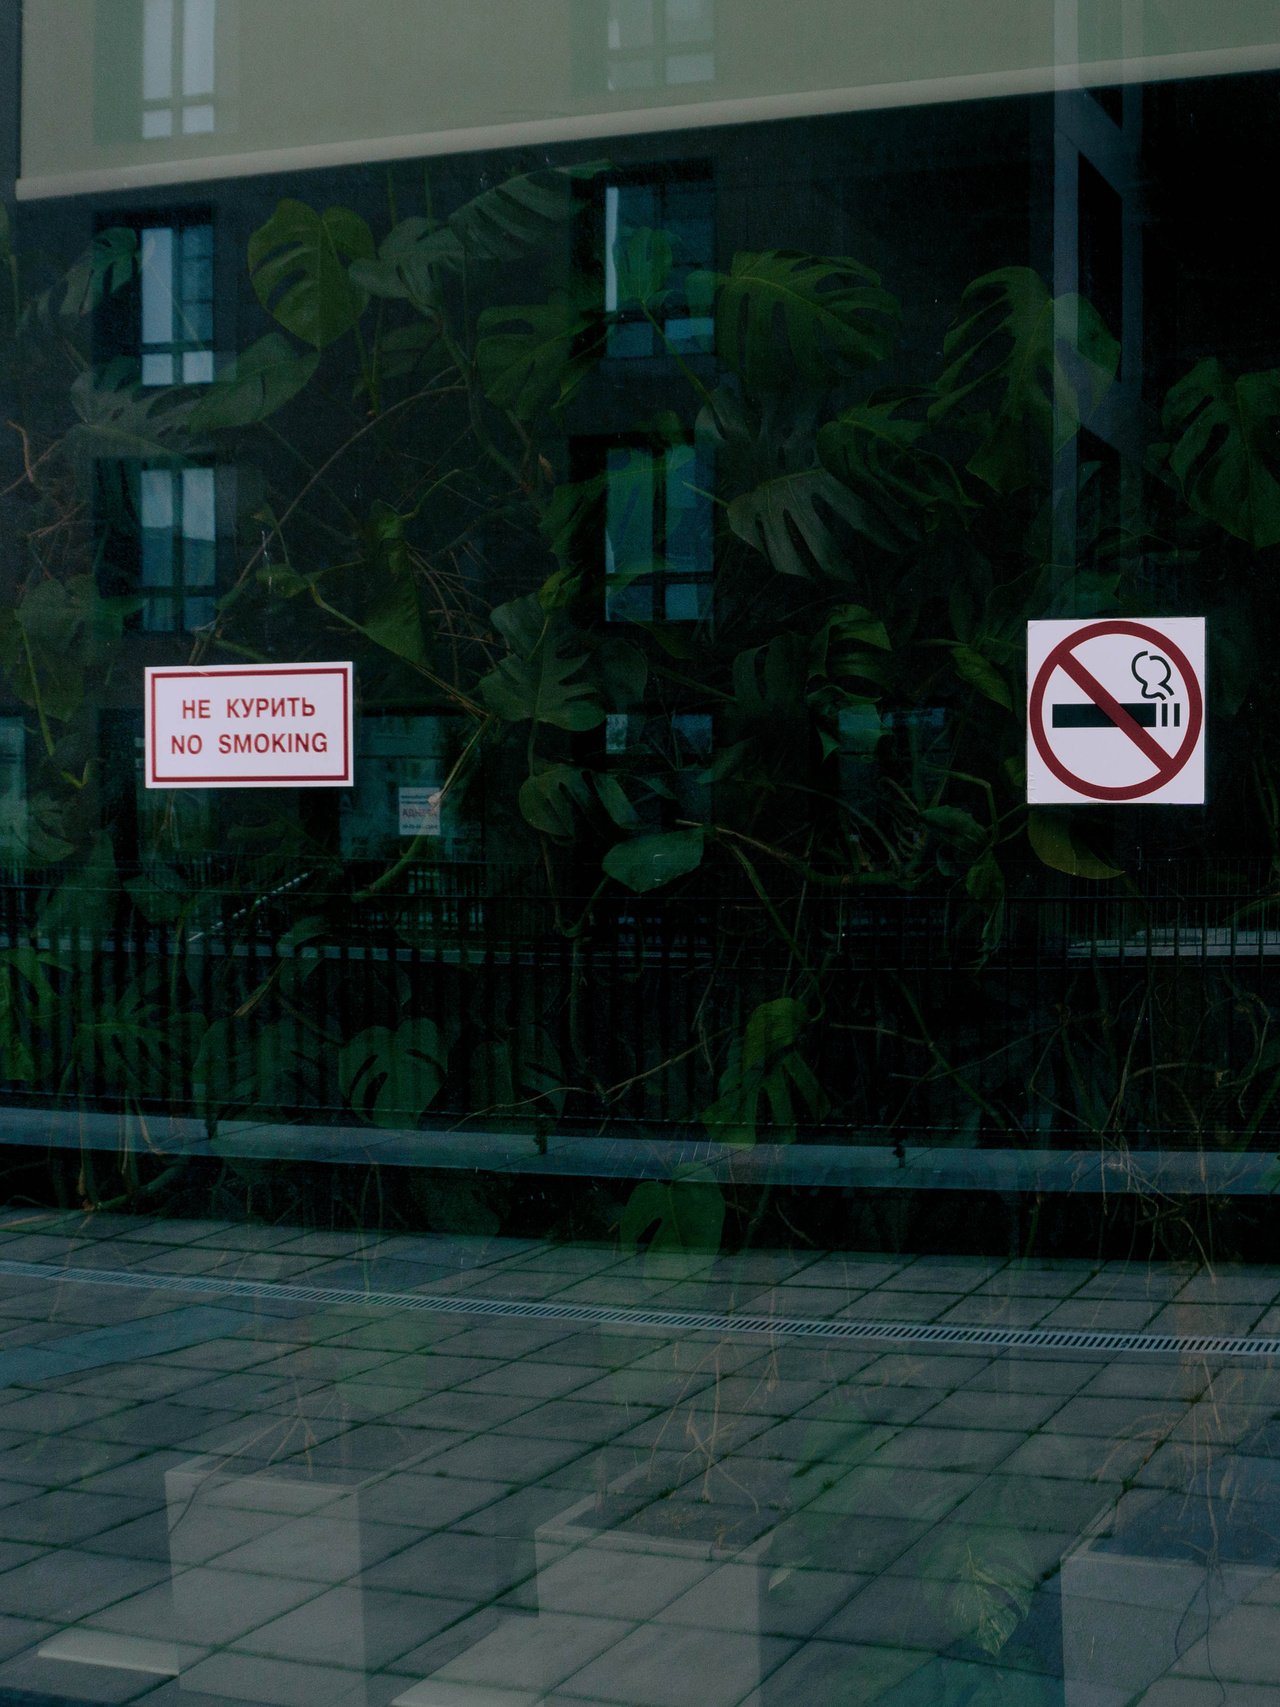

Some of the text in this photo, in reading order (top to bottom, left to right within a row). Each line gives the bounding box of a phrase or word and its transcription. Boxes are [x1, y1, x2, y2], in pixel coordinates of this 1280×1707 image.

[182, 696, 315, 719] НЕ КУРИТЬ
[170, 731, 328, 755] NO SMOKING
